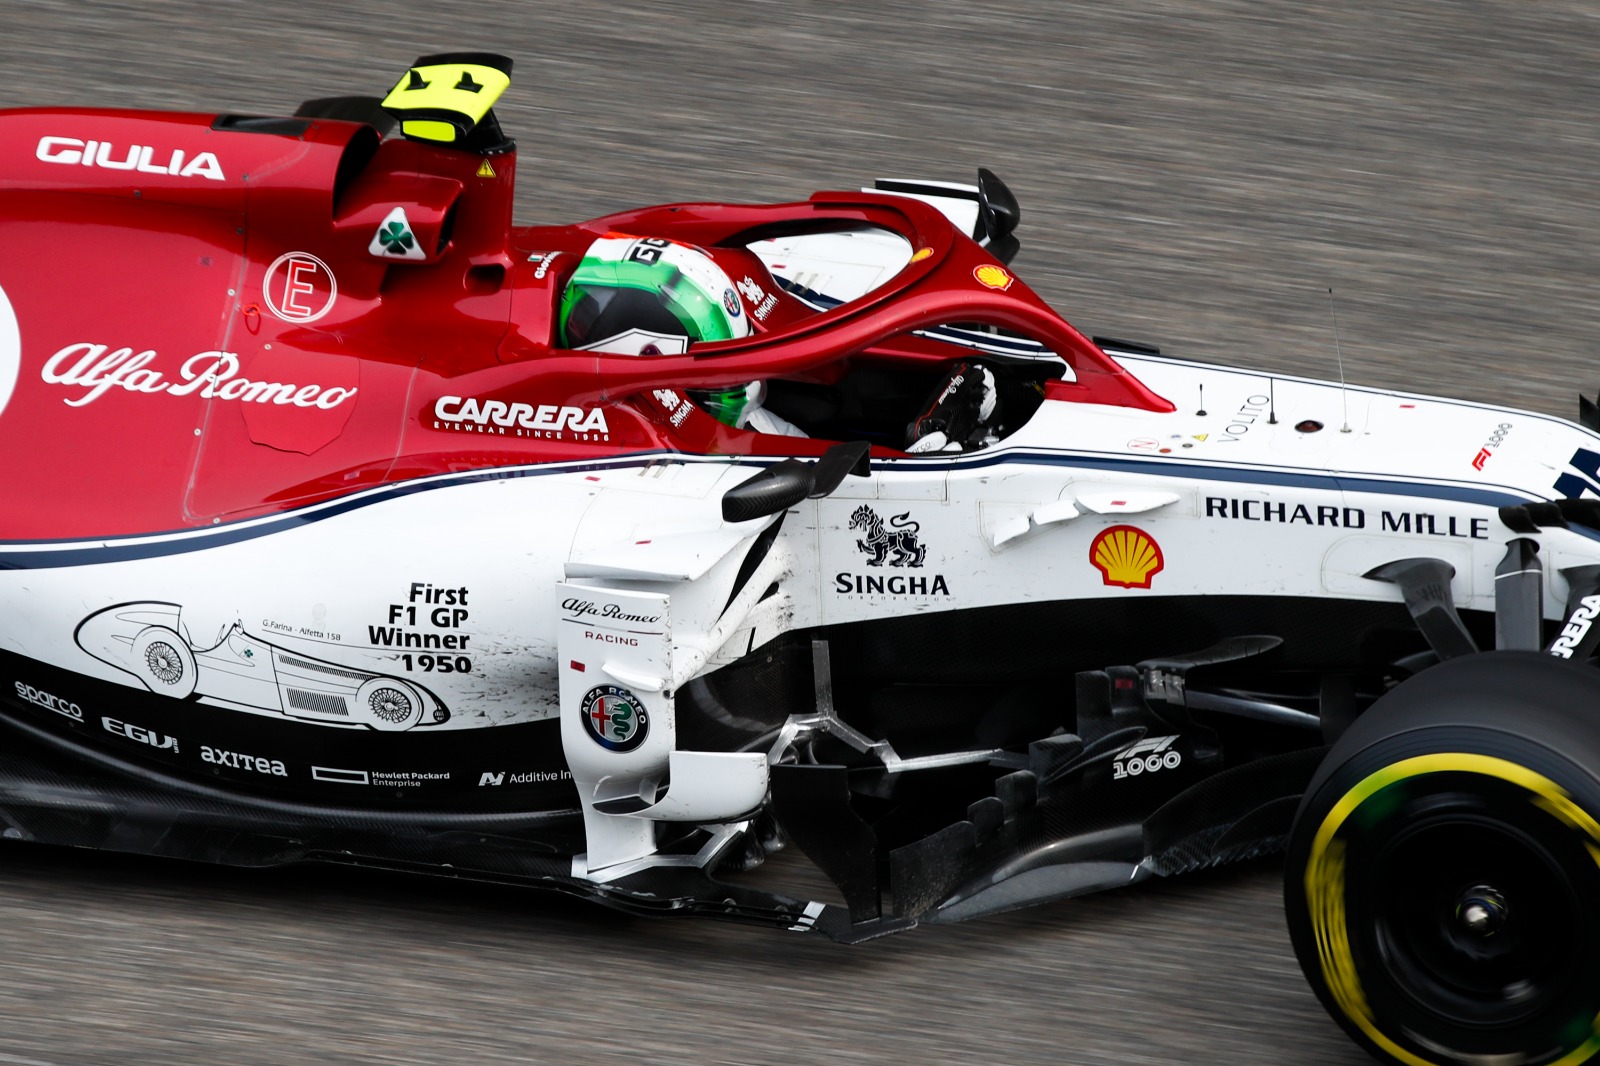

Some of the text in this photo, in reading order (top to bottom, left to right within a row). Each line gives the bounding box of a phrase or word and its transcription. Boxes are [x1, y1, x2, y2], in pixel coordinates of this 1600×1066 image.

[36, 135, 225, 181] GIULIA
[282, 258, 317, 317] E
[754, 293, 779, 321] SINGHA
[41, 342, 357, 409] Alfa Romeo
[434, 395, 609, 433] CARRERA
[670, 399, 694, 428] SINGHA
[1217, 395, 1269, 442] VOLITO
[434, 421, 609, 442] EYEWEAR SINCE 1956
[1205, 496, 1489, 540] RICHARD MILLE
[409, 582, 469, 606] First
[835, 572, 950, 596] SINGHA
[388, 604, 469, 628] F1 GP
[561, 597, 662, 624] Alfa Romeo
[326, 632, 341, 641] 158
[368, 625, 470, 650] Winner
[585, 630, 639, 647] RACING
[1550, 594, 1600, 659] RERA
[402, 654, 472, 673] 1950
[14, 680, 83, 718] sparco
[582, 687, 604, 716] ALFA
[371, 771, 450, 781] Hewlett Packard
[509, 771, 558, 784] Additive
[560, 769, 572, 780] In
[1112, 750, 1182, 780] 1000
[373, 779, 421, 788] Enterprise
